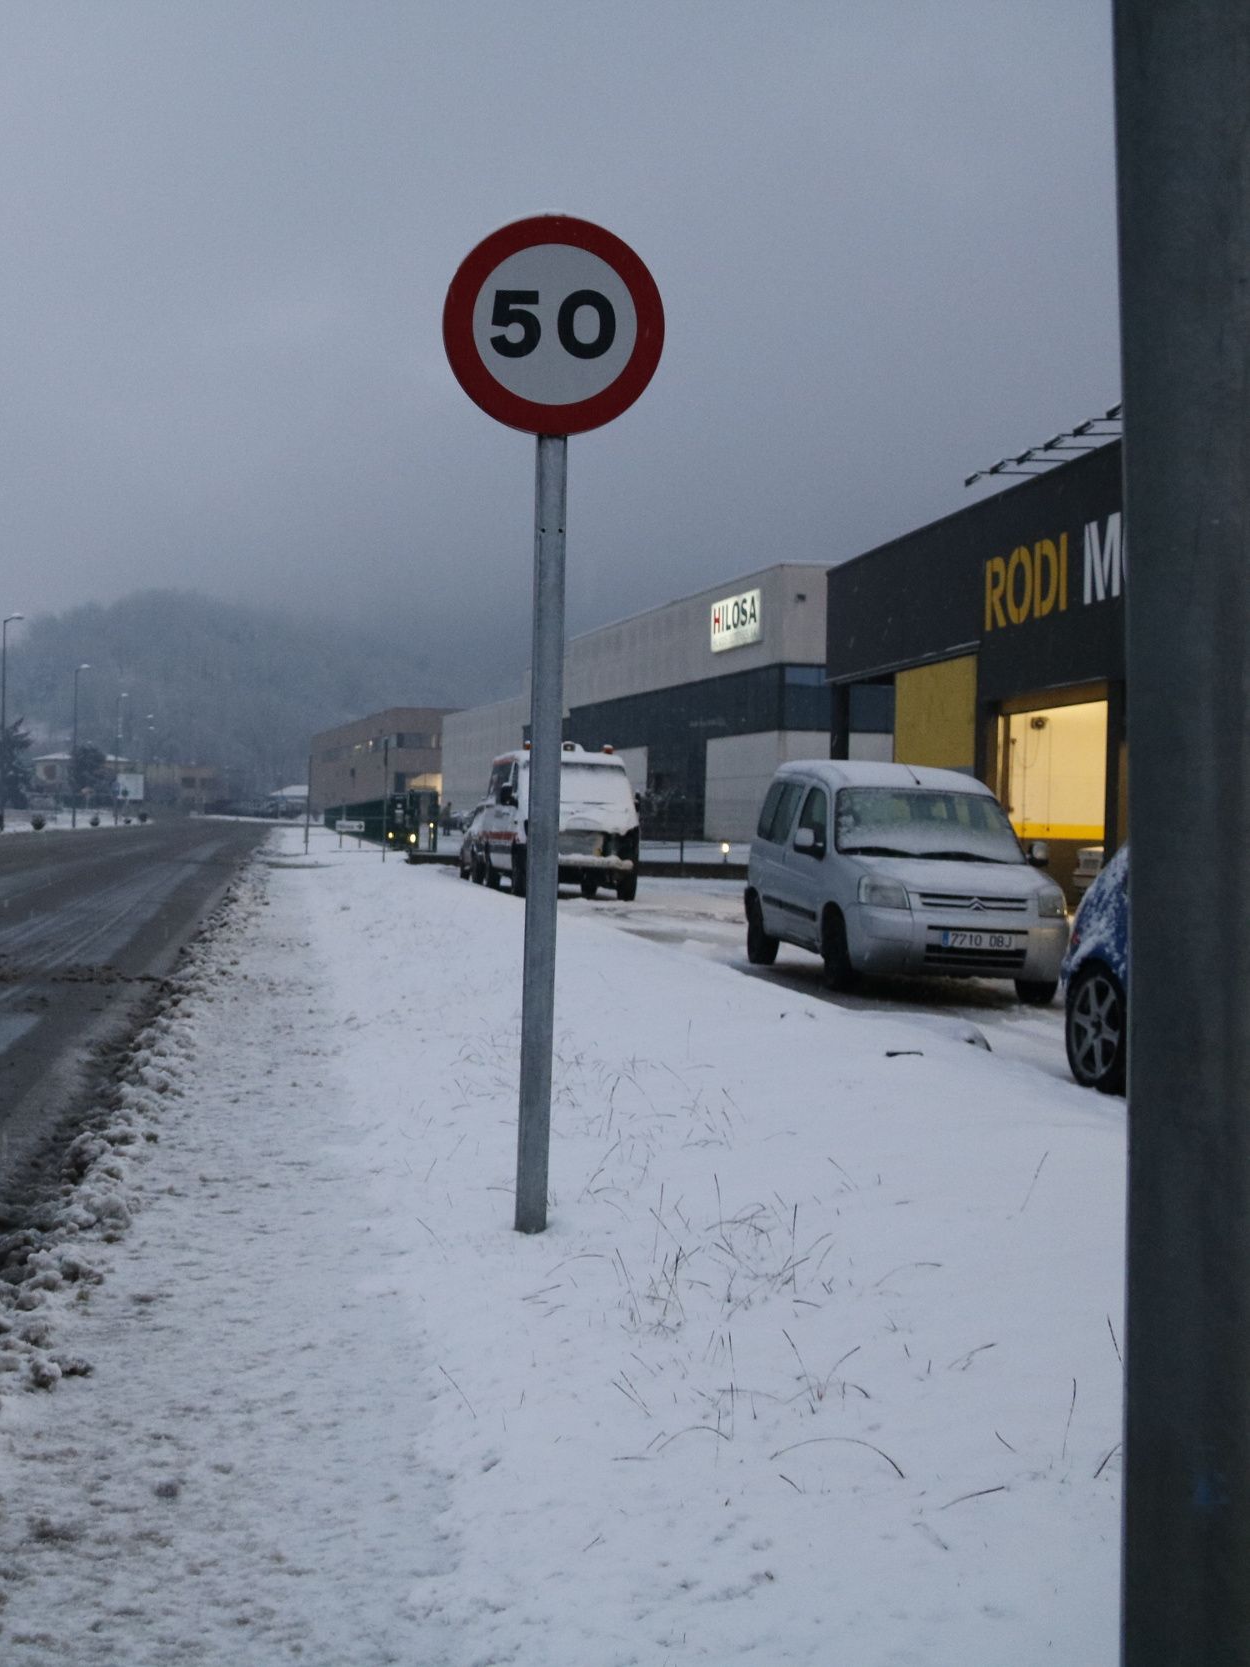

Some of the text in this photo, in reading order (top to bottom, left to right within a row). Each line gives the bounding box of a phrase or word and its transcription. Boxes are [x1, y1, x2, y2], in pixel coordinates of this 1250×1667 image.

[490, 289, 616, 359] 50
[985, 512, 1126, 631] RODI M
[713, 595, 757, 635] HILOSA
[951, 932, 982, 947] 7710
